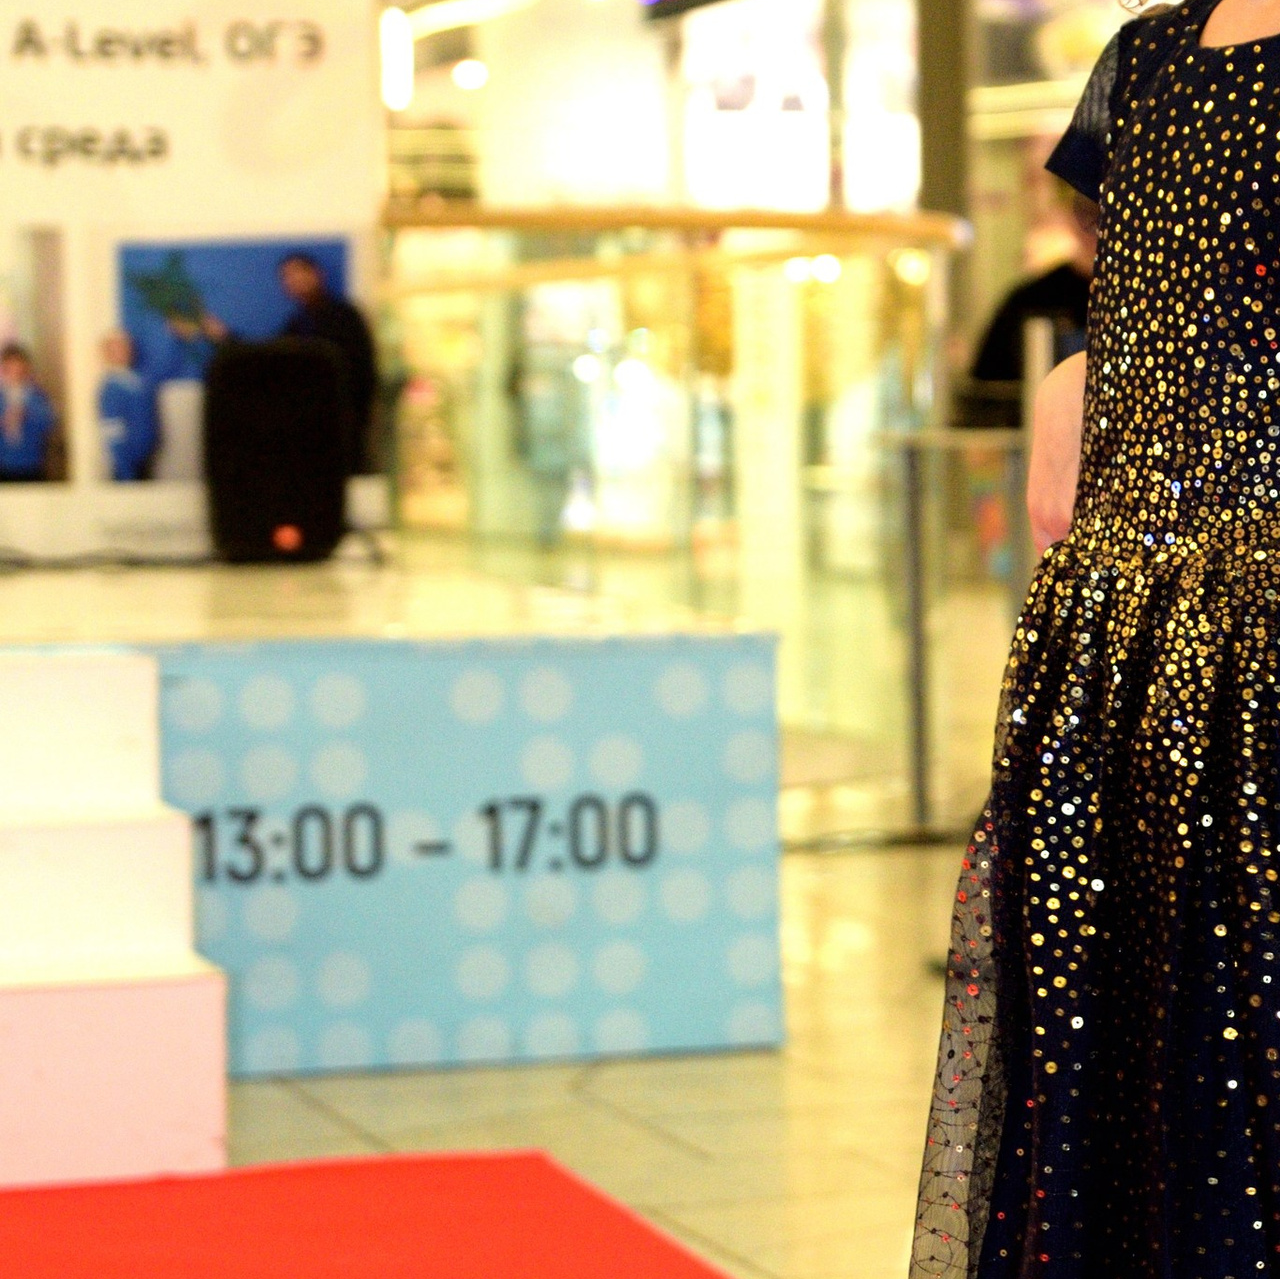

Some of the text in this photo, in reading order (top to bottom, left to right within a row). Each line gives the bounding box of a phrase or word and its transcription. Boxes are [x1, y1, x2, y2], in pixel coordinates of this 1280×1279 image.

[224, 19, 326, 68] ОГЭ
[14, 124, 170, 169] среда
[196, 801, 386, 885] 13:00
[478, 791, 660, 874] 17:00
